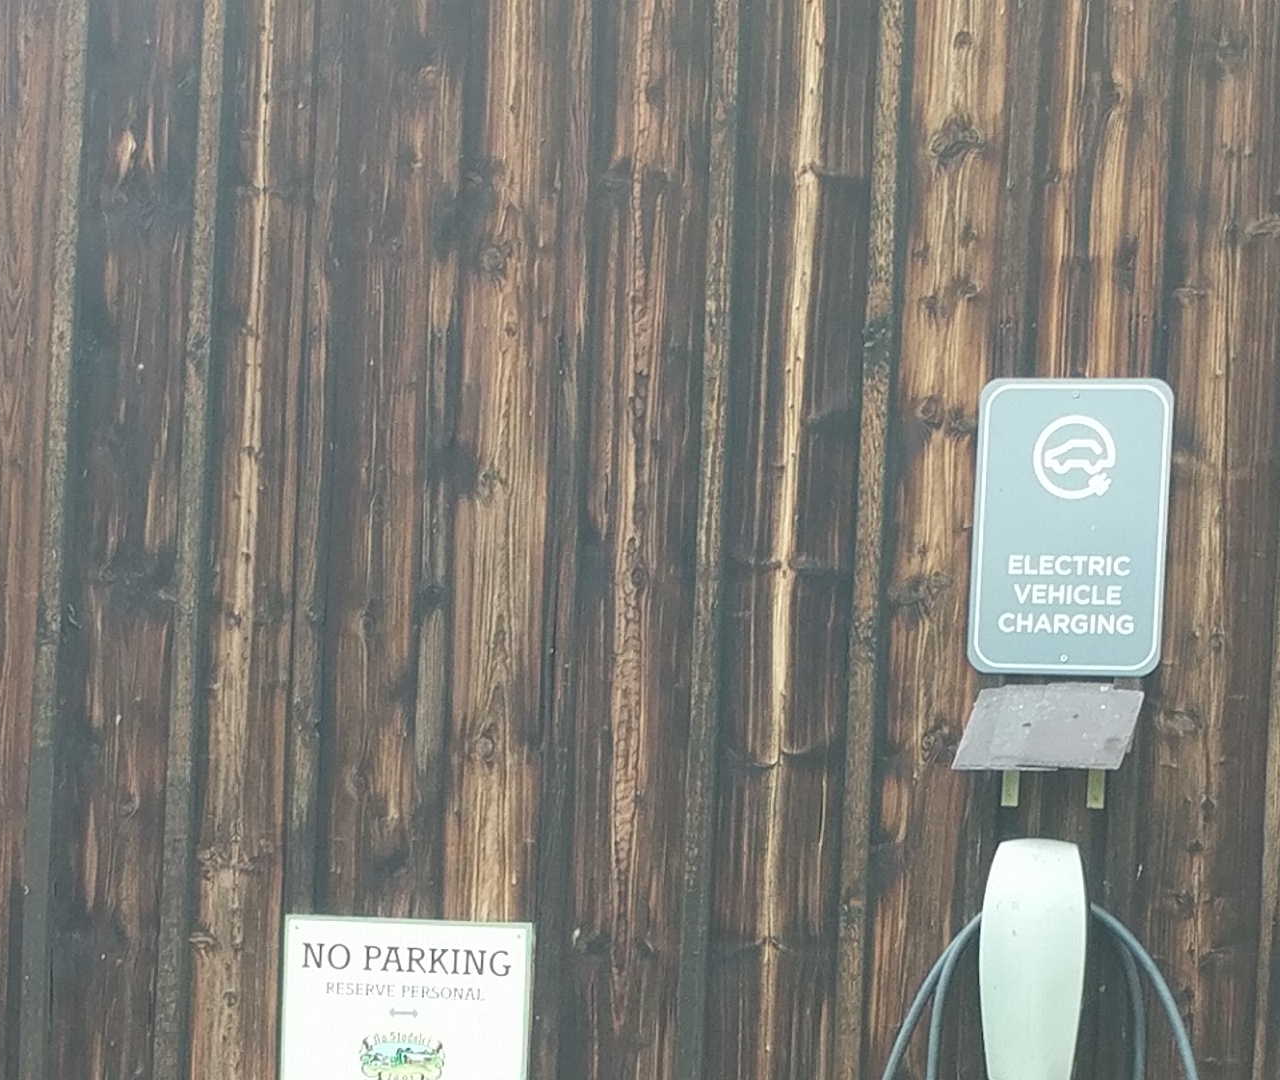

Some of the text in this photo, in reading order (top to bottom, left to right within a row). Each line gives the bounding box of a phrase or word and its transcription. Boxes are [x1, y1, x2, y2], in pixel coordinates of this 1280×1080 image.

[1009, 555, 1130, 576] ELECTRIC
[1014, 584, 1122, 605] VEHICLE
[999, 613, 1133, 634] CHARGING
[302, 943, 511, 976] NO PARKING
[326, 982, 485, 1001] RESERVE PERSONAL
